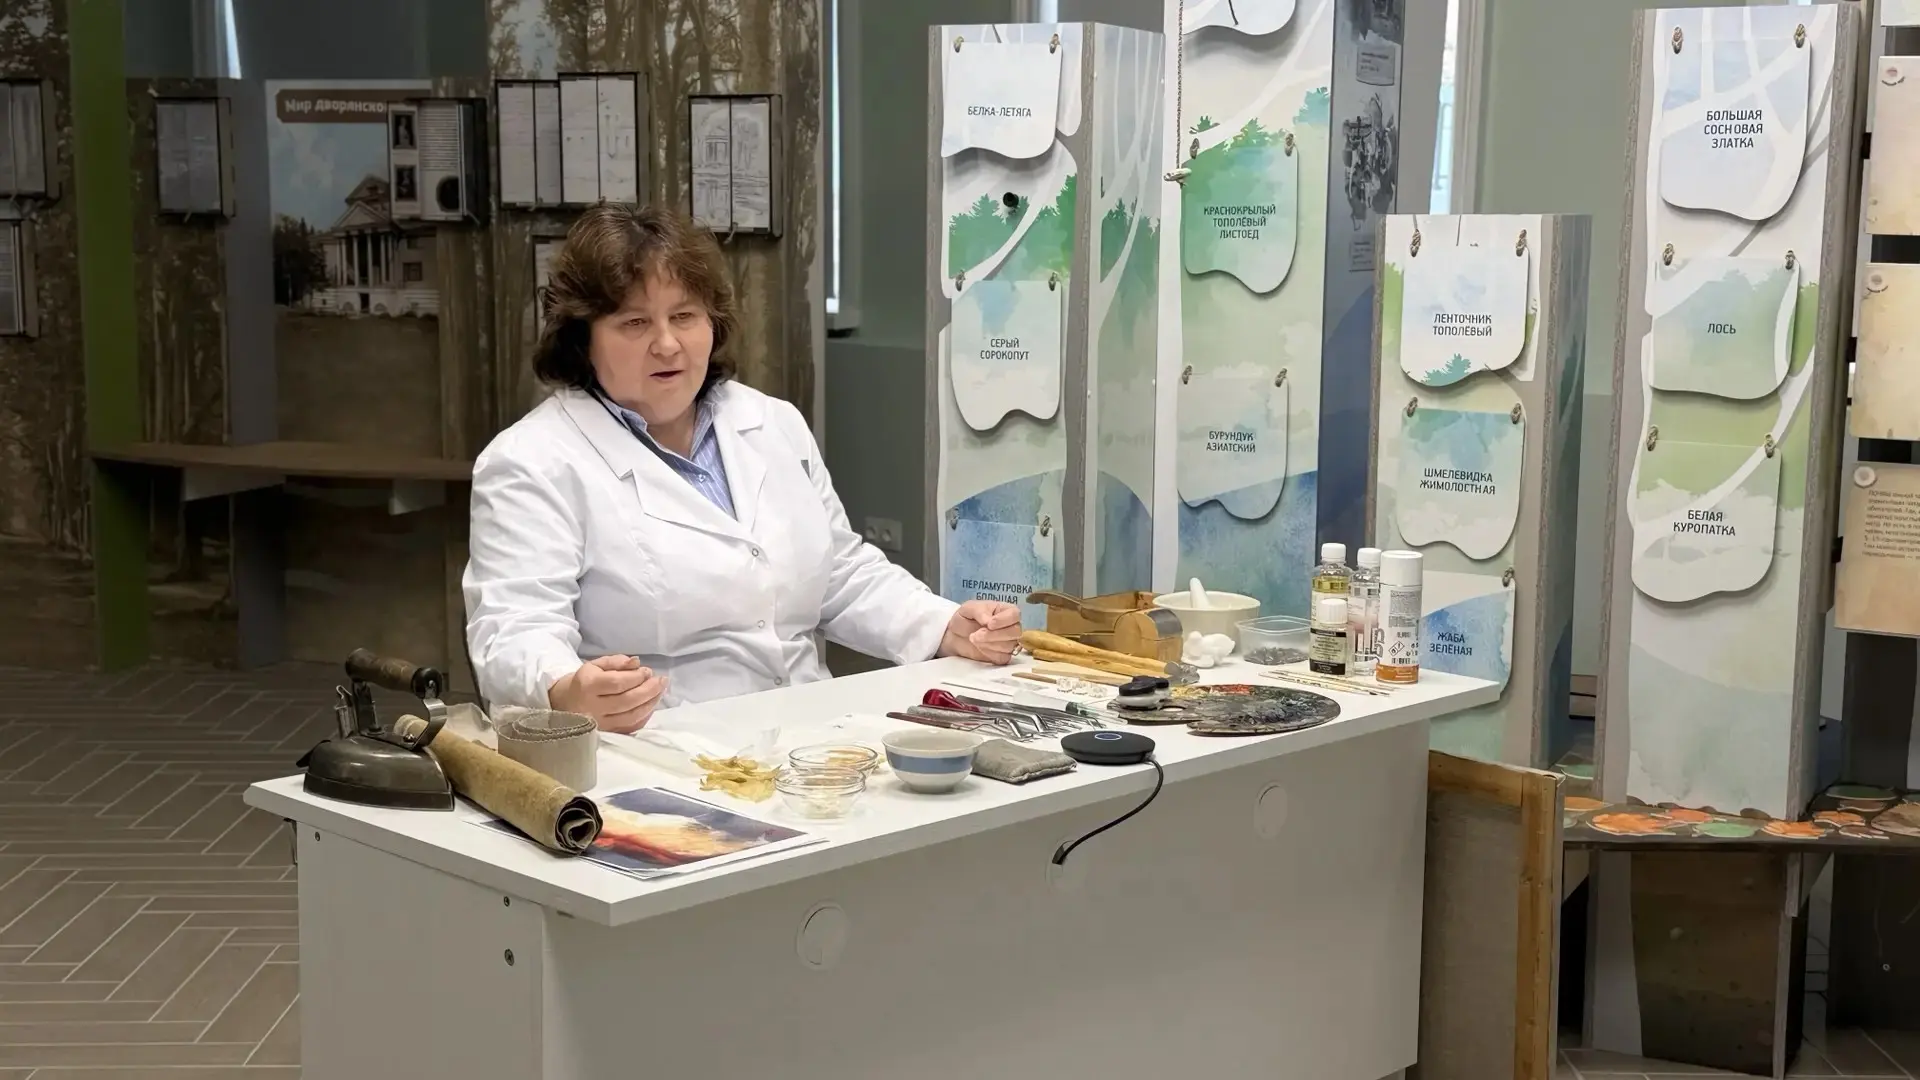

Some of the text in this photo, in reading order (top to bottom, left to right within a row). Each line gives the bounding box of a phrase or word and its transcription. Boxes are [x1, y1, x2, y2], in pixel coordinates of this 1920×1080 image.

[284, 99, 387, 115] Мир дворянско
[967, 105, 1032, 117] БЕЛКА-ЛЕТЯГА
[1706, 109, 1762, 121] БОЛЬШАЯ
[1704, 123, 1763, 135] СОСНОВАЯ
[1711, 137, 1754, 149] ЗЛАТКА
[1203, 203, 1276, 216] КРАСНОКРЫЛЫЙ
[1213, 216, 1267, 228] ТОПОЛЁВЫЙ
[1219, 229, 1259, 241] ЛИСТОЕД
[1433, 313, 1492, 324] ЛЕНТОЧНИК
[1432, 325, 1492, 337] ТОПОЛЁВЫЙ
[1707, 323, 1737, 335] ЛОСЬ
[990, 337, 1020, 349] СЕРЫЙ
[979, 349, 1029, 361] СОРОКОПУТ
[1208, 430, 1254, 442] БУРУНДУК
[1205, 441, 1256, 453] АЗИАТСКИЙ
[1424, 467, 1493, 483] ШМЕЛЕВИДКА
[1419, 479, 1496, 495] ЖИМОЛОСТНАЯ
[1687, 509, 1723, 522] БЕЛАЯ
[1672, 521, 1736, 536] КУРОПАТКА
[961, 579, 1034, 594] ПЕРЛАМУТРОВКА
[1437, 631, 1466, 644] ЖАБА
